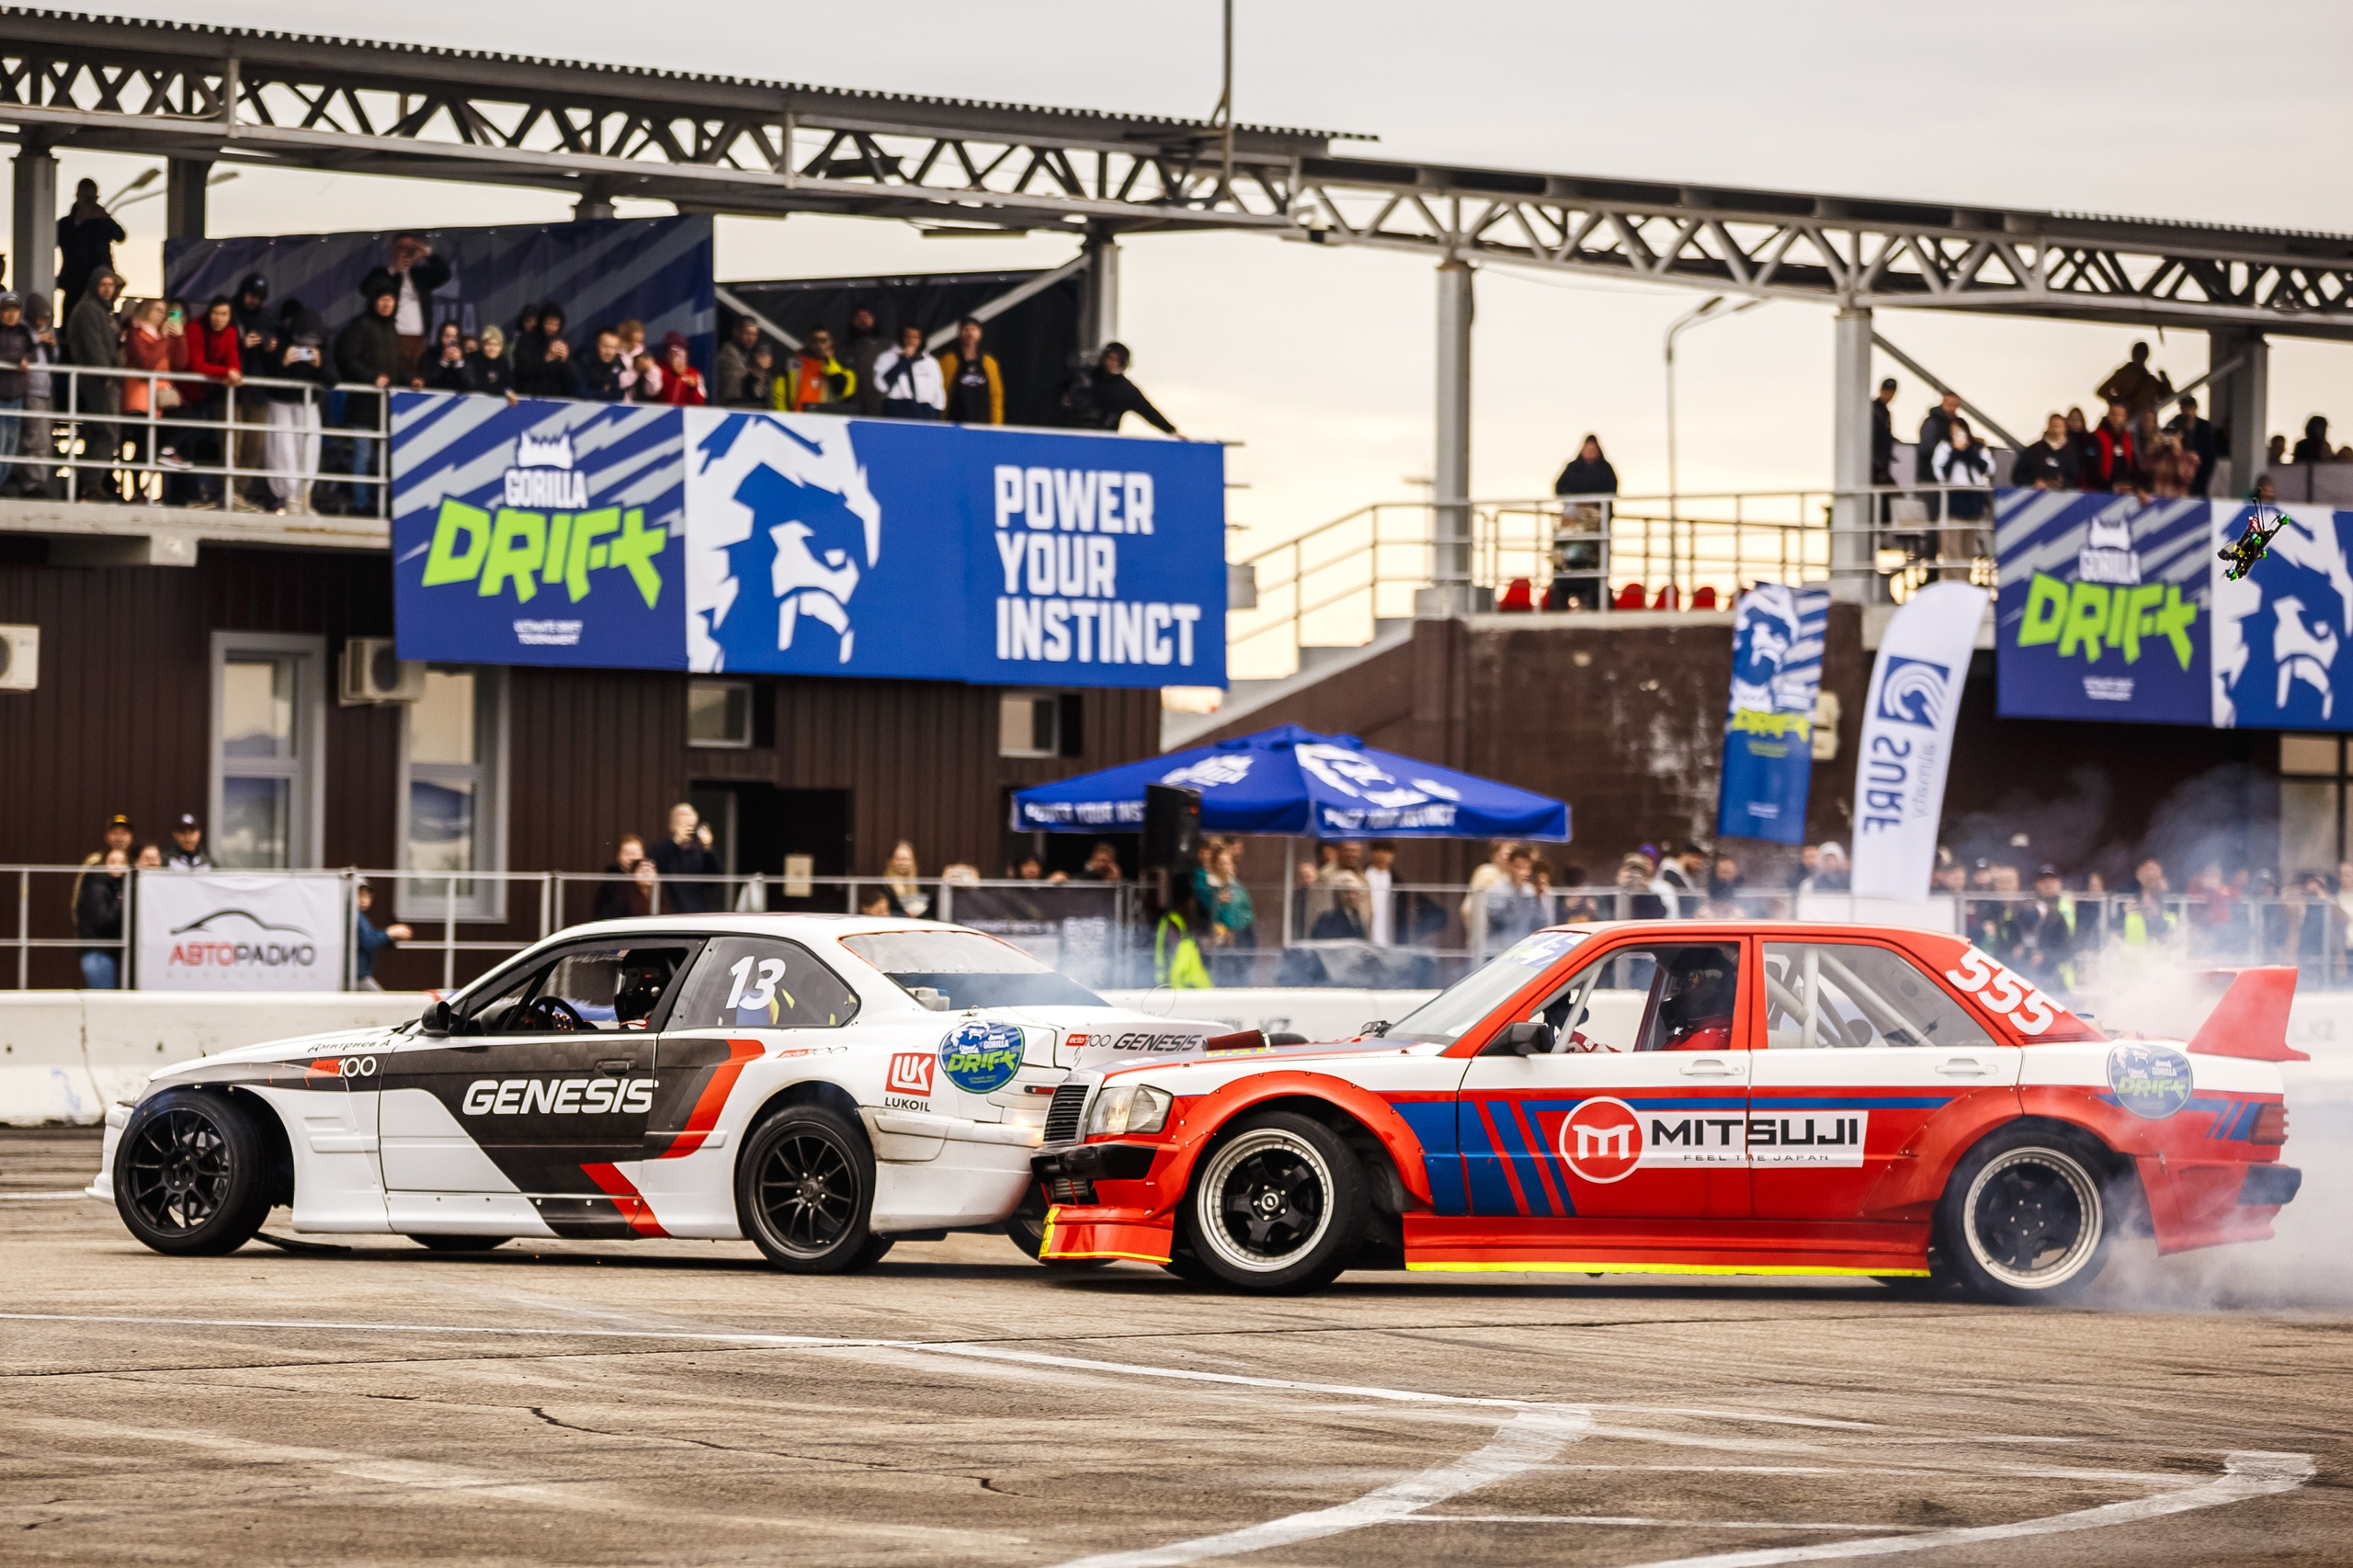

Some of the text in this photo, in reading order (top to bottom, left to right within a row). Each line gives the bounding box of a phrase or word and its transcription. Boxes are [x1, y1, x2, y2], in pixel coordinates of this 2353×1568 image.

[505, 469, 588, 509] GORILLA
[994, 464, 1154, 535] POWER
[421, 498, 666, 609] DRIFT
[994, 530, 1117, 598] YOUR
[995, 596, 1201, 666] INSTINCT
[2017, 571, 2198, 672] DRIFT
[168, 942, 317, 967] АВТОРАДИО
[725, 955, 787, 1011] 13
[1944, 945, 2067, 1036] 555
[307, 1041, 376, 1053] Дмитриев
[983, 1039, 1010, 1050] GORILLA
[1112, 1032, 1203, 1051] GENESIS
[946, 1050, 1017, 1074] DRIFT
[2151, 1065, 2177, 1077] GORILLA
[461, 1077, 660, 1116] GENESIS
[2116, 1076, 2187, 1102] DRIFT
[884, 1096, 931, 1113] LUKOIL
[1651, 1118, 1859, 1147] MITSUJI
[1683, 1153, 1829, 1162] FEEL THE JAPAN
